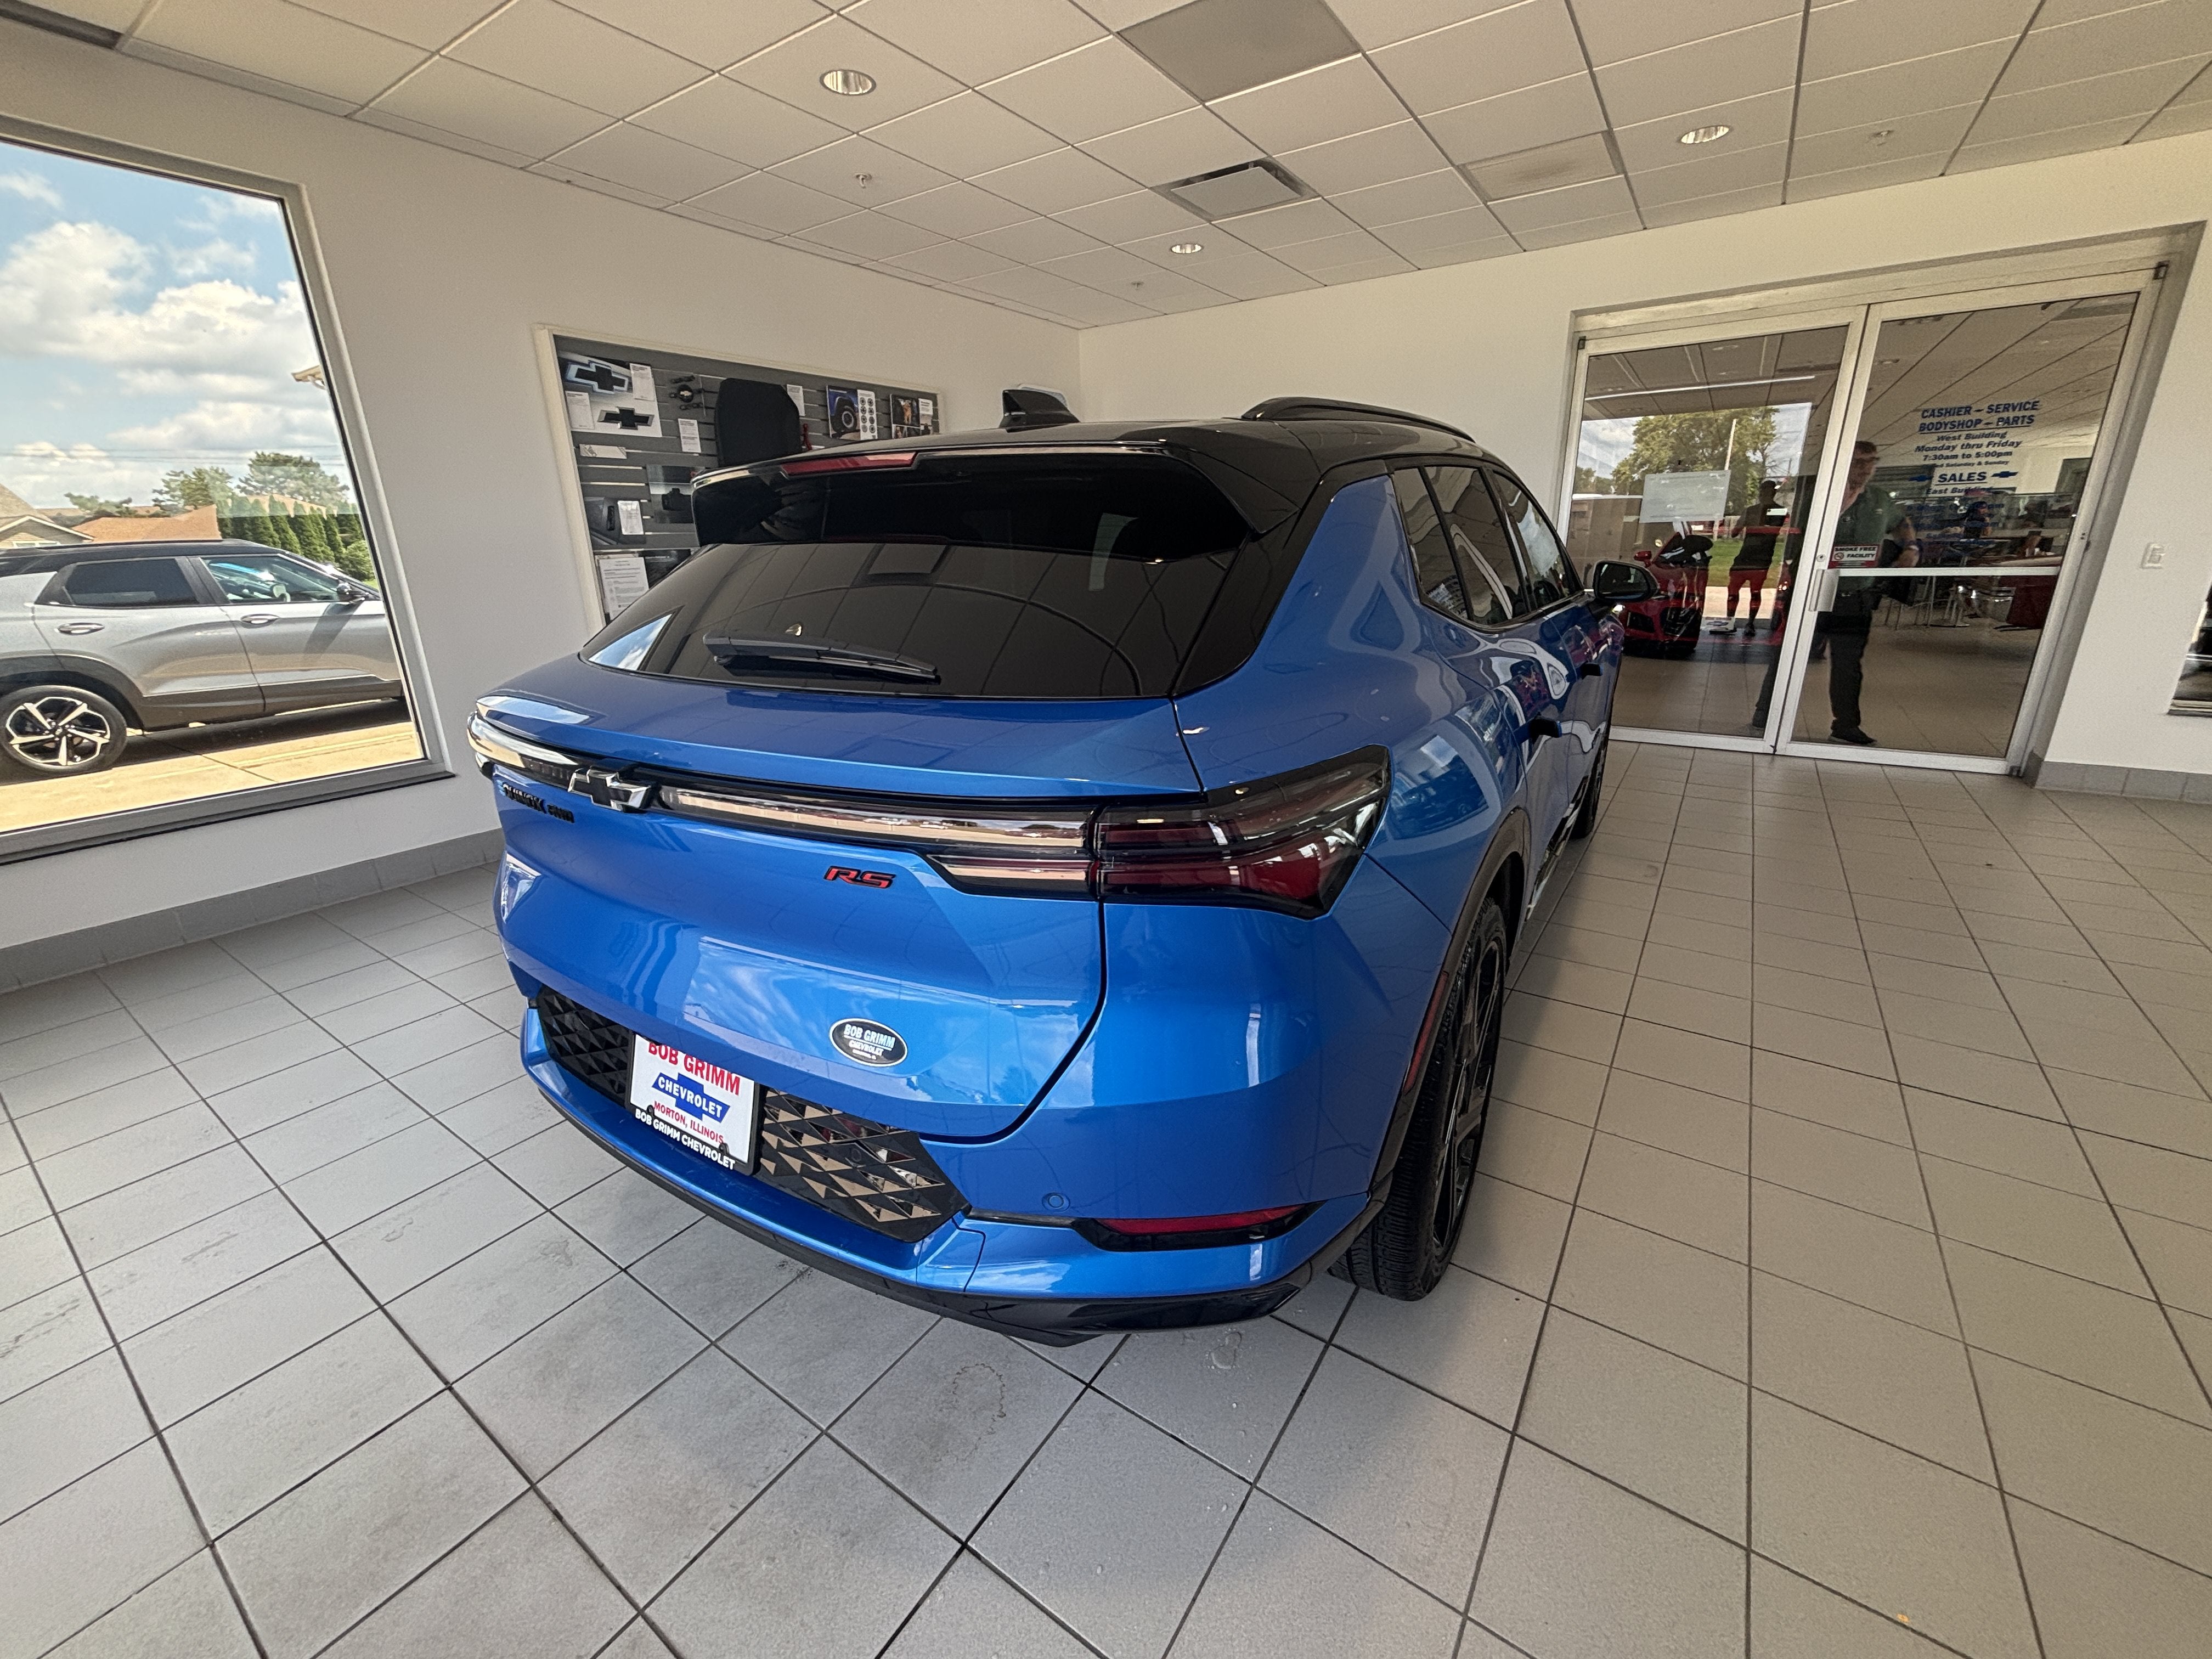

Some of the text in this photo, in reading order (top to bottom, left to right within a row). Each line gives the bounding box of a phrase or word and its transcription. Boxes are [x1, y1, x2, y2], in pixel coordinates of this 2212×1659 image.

[1921, 405, 1972, 419] CASHIER
[1986, 400, 2040, 414] SERVICE
[1918, 419, 1983, 432] BODYSHOP
[1996, 415, 2035, 427] PARTS
[1964, 431, 2008, 440] Building
[1914, 440, 2023, 453] Monday thru Friday
[1975, 450, 2013, 459] 5:00pm
[1937, 471, 1988, 483] SALES
[1951, 486, 1994, 494] Build
[823, 866, 897, 889] RS
[843, 1024, 896, 1048] BOB GRIMM
[849, 1040, 884, 1057] CHEVROLET
[648, 1042, 741, 1096] BOB GRIMM
[658, 1076, 723, 1120] CHEVROLET
[654, 1101, 724, 1144] MORTON, ILLINOIS
[635, 1108, 736, 1170] BOB GRIMM CHEVROLET
